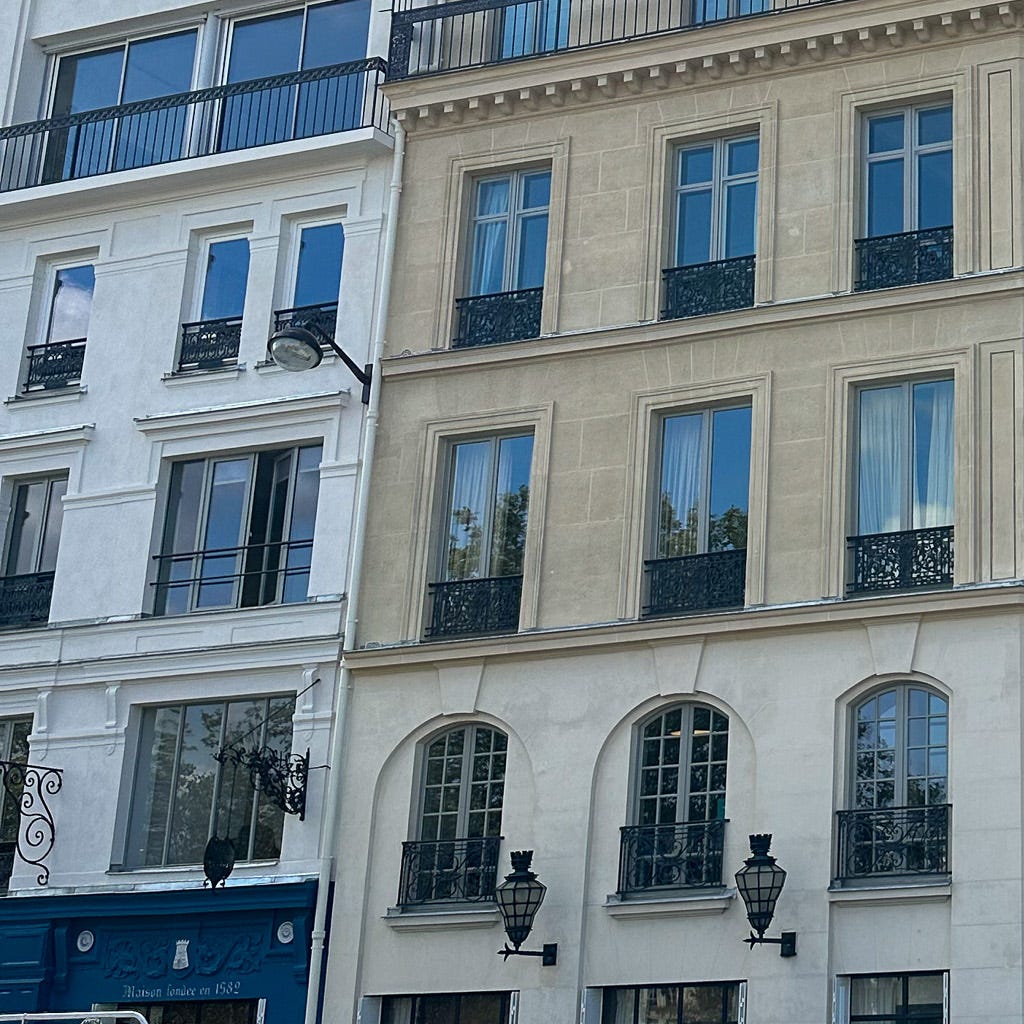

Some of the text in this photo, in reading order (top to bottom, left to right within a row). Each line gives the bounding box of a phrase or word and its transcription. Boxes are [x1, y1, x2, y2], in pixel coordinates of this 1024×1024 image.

[122, 984, 162, 998] Maison
[199, 987, 211, 995] en
[215, 981, 241, 995] 1582
